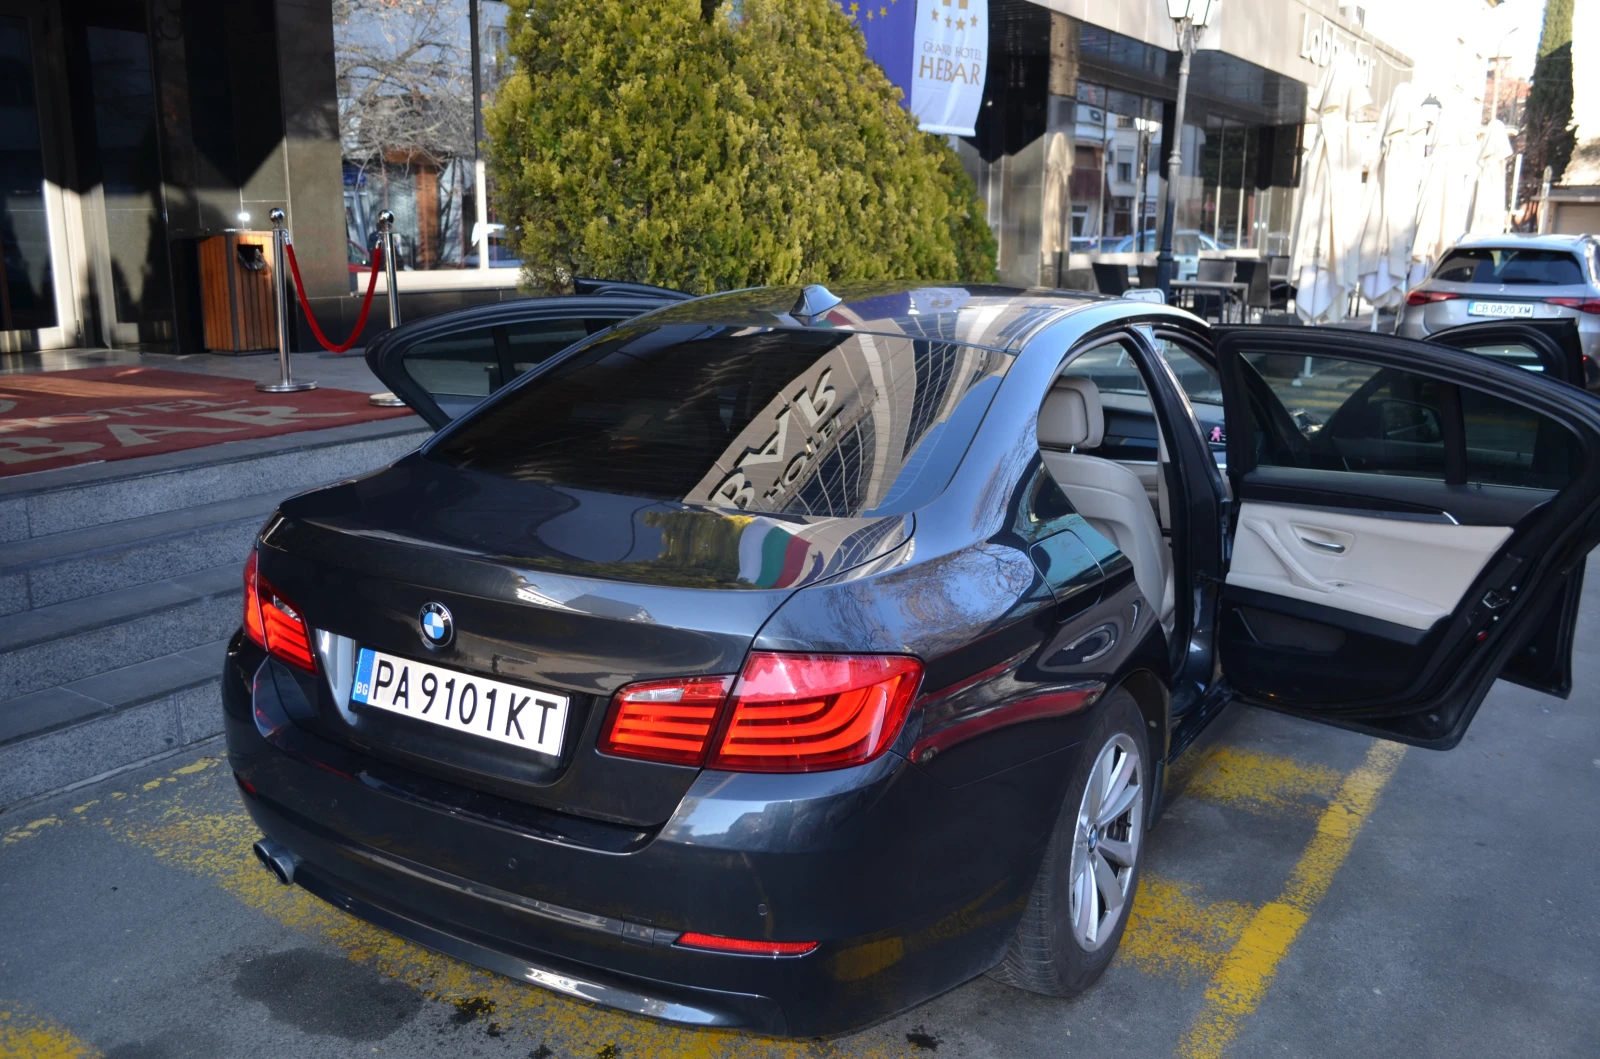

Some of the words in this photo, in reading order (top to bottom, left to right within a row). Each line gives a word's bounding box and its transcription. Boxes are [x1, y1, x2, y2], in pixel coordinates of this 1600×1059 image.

[923, 41, 952, 56] GRAND
[955, 47, 982, 60] HOTEL
[919, 55, 981, 86] HEBAR
[355, 681, 369, 696] BG
